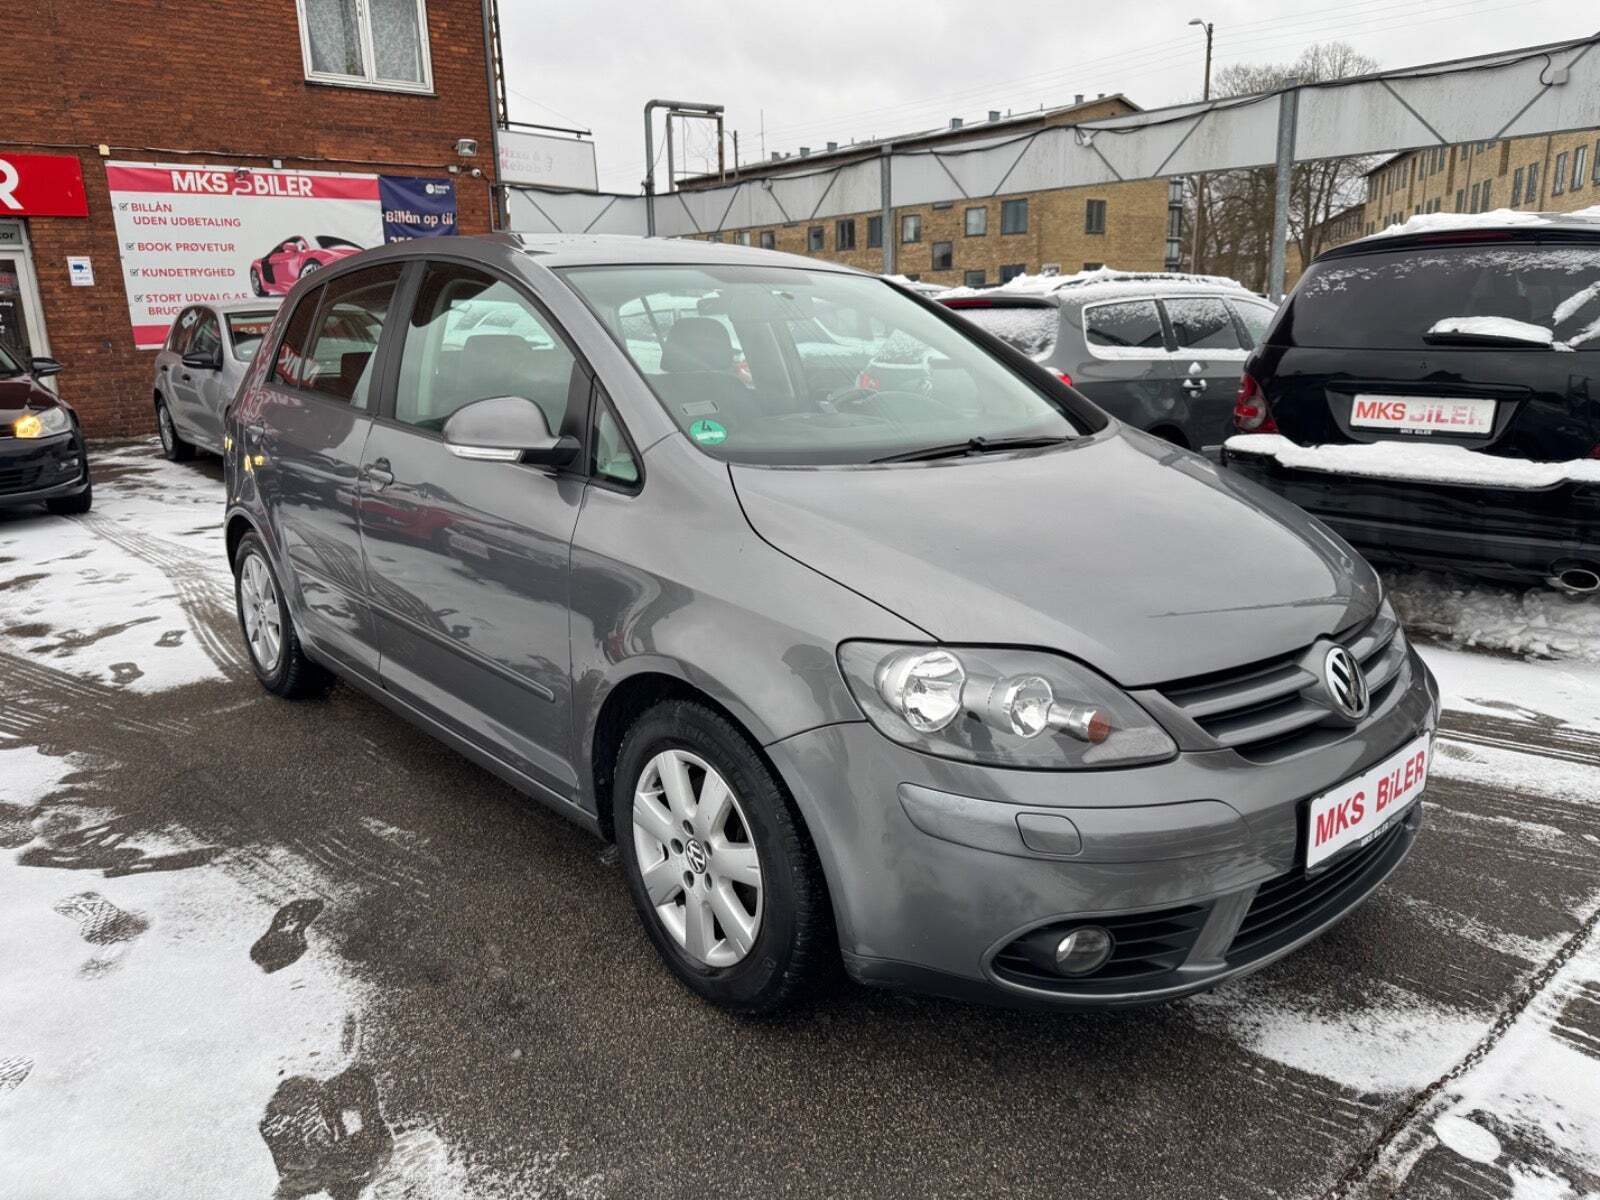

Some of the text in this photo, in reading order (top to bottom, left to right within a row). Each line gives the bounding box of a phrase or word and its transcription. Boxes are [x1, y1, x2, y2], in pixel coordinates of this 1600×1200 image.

[170, 171, 314, 197] MKS BILER
[131, 201, 173, 213] BILLÅN
[133, 215, 242, 228] UDEN UDBETALING
[386, 210, 453, 227] Billån op til
[137, 242, 236, 253] BOOK PRØVETUR
[142, 268, 236, 278] KUNDETRYGHED
[145, 293, 182, 303] STORT
[148, 306, 183, 316] BRUG
[1355, 402, 1407, 421] MKS
[1315, 791, 1365, 848] MKS
